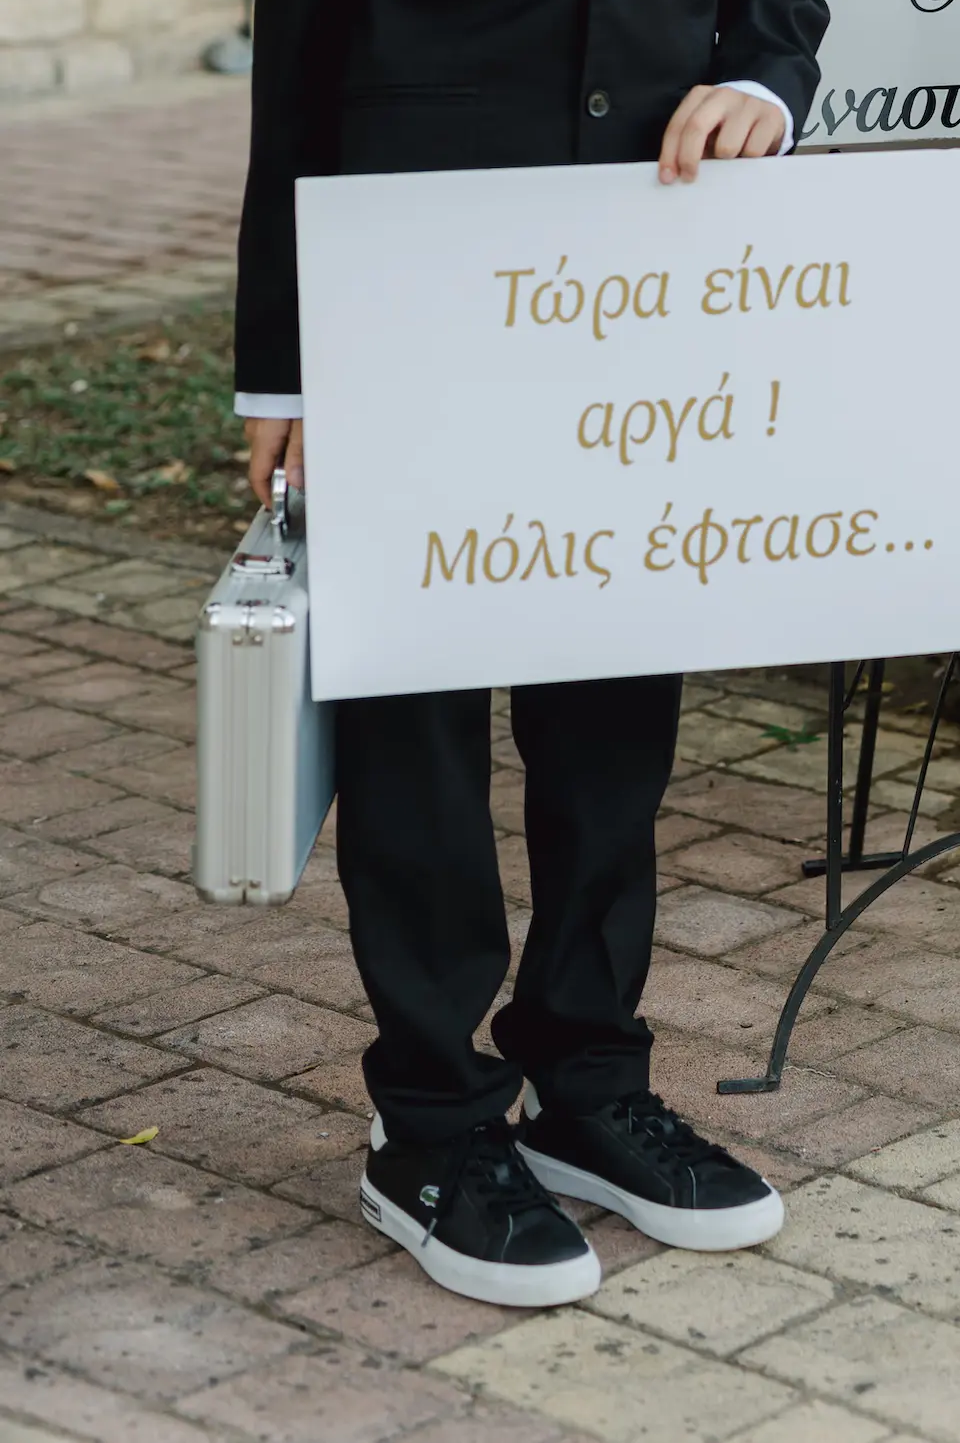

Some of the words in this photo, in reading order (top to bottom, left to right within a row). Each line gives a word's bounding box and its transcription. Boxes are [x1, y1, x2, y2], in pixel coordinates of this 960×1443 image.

[493, 254, 671, 342] Τώρα
[700, 244, 851, 316] είναι
[577, 372, 735, 467] αργά
[420, 513, 615, 590] Μόλις
[643, 501, 935, 586] έφτασε...
